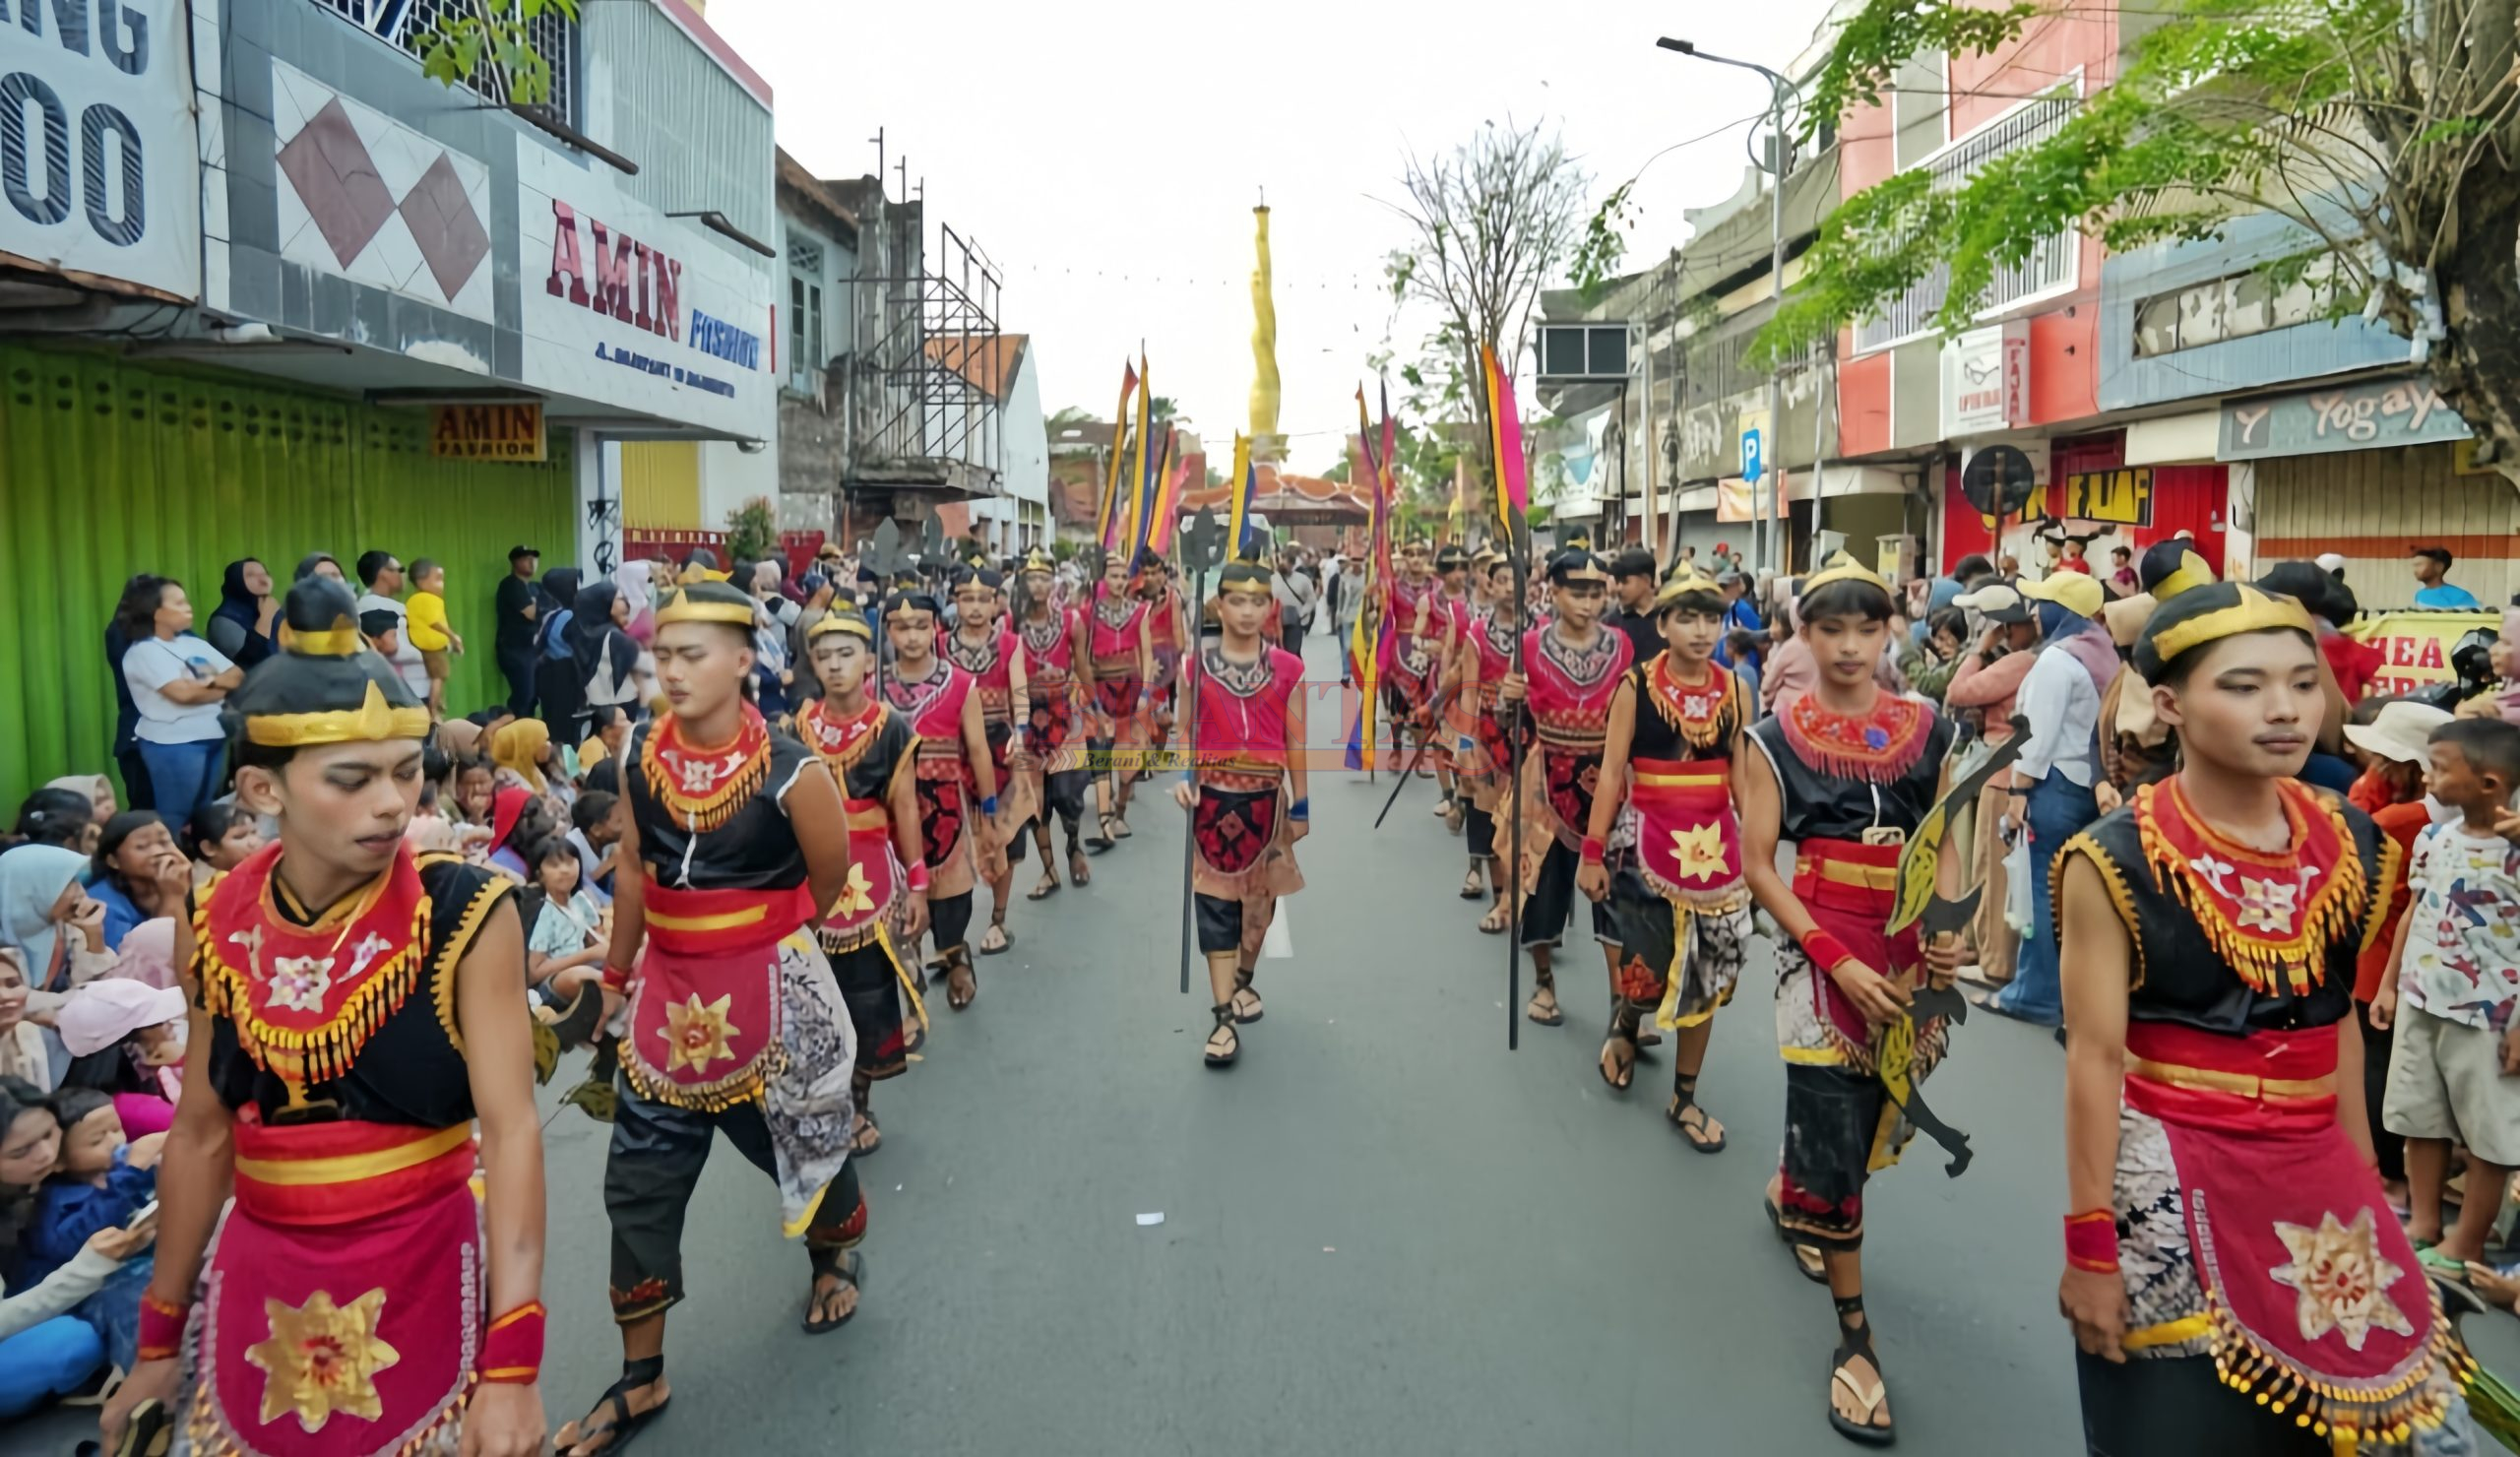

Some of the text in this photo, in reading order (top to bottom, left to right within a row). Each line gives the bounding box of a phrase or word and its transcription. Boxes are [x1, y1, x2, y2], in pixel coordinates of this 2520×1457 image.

[546, 198, 682, 343] AMIN
[437, 405, 535, 440] AMIN
[2308, 381, 2448, 441] Yogay
[1745, 438, 1757, 473] P
